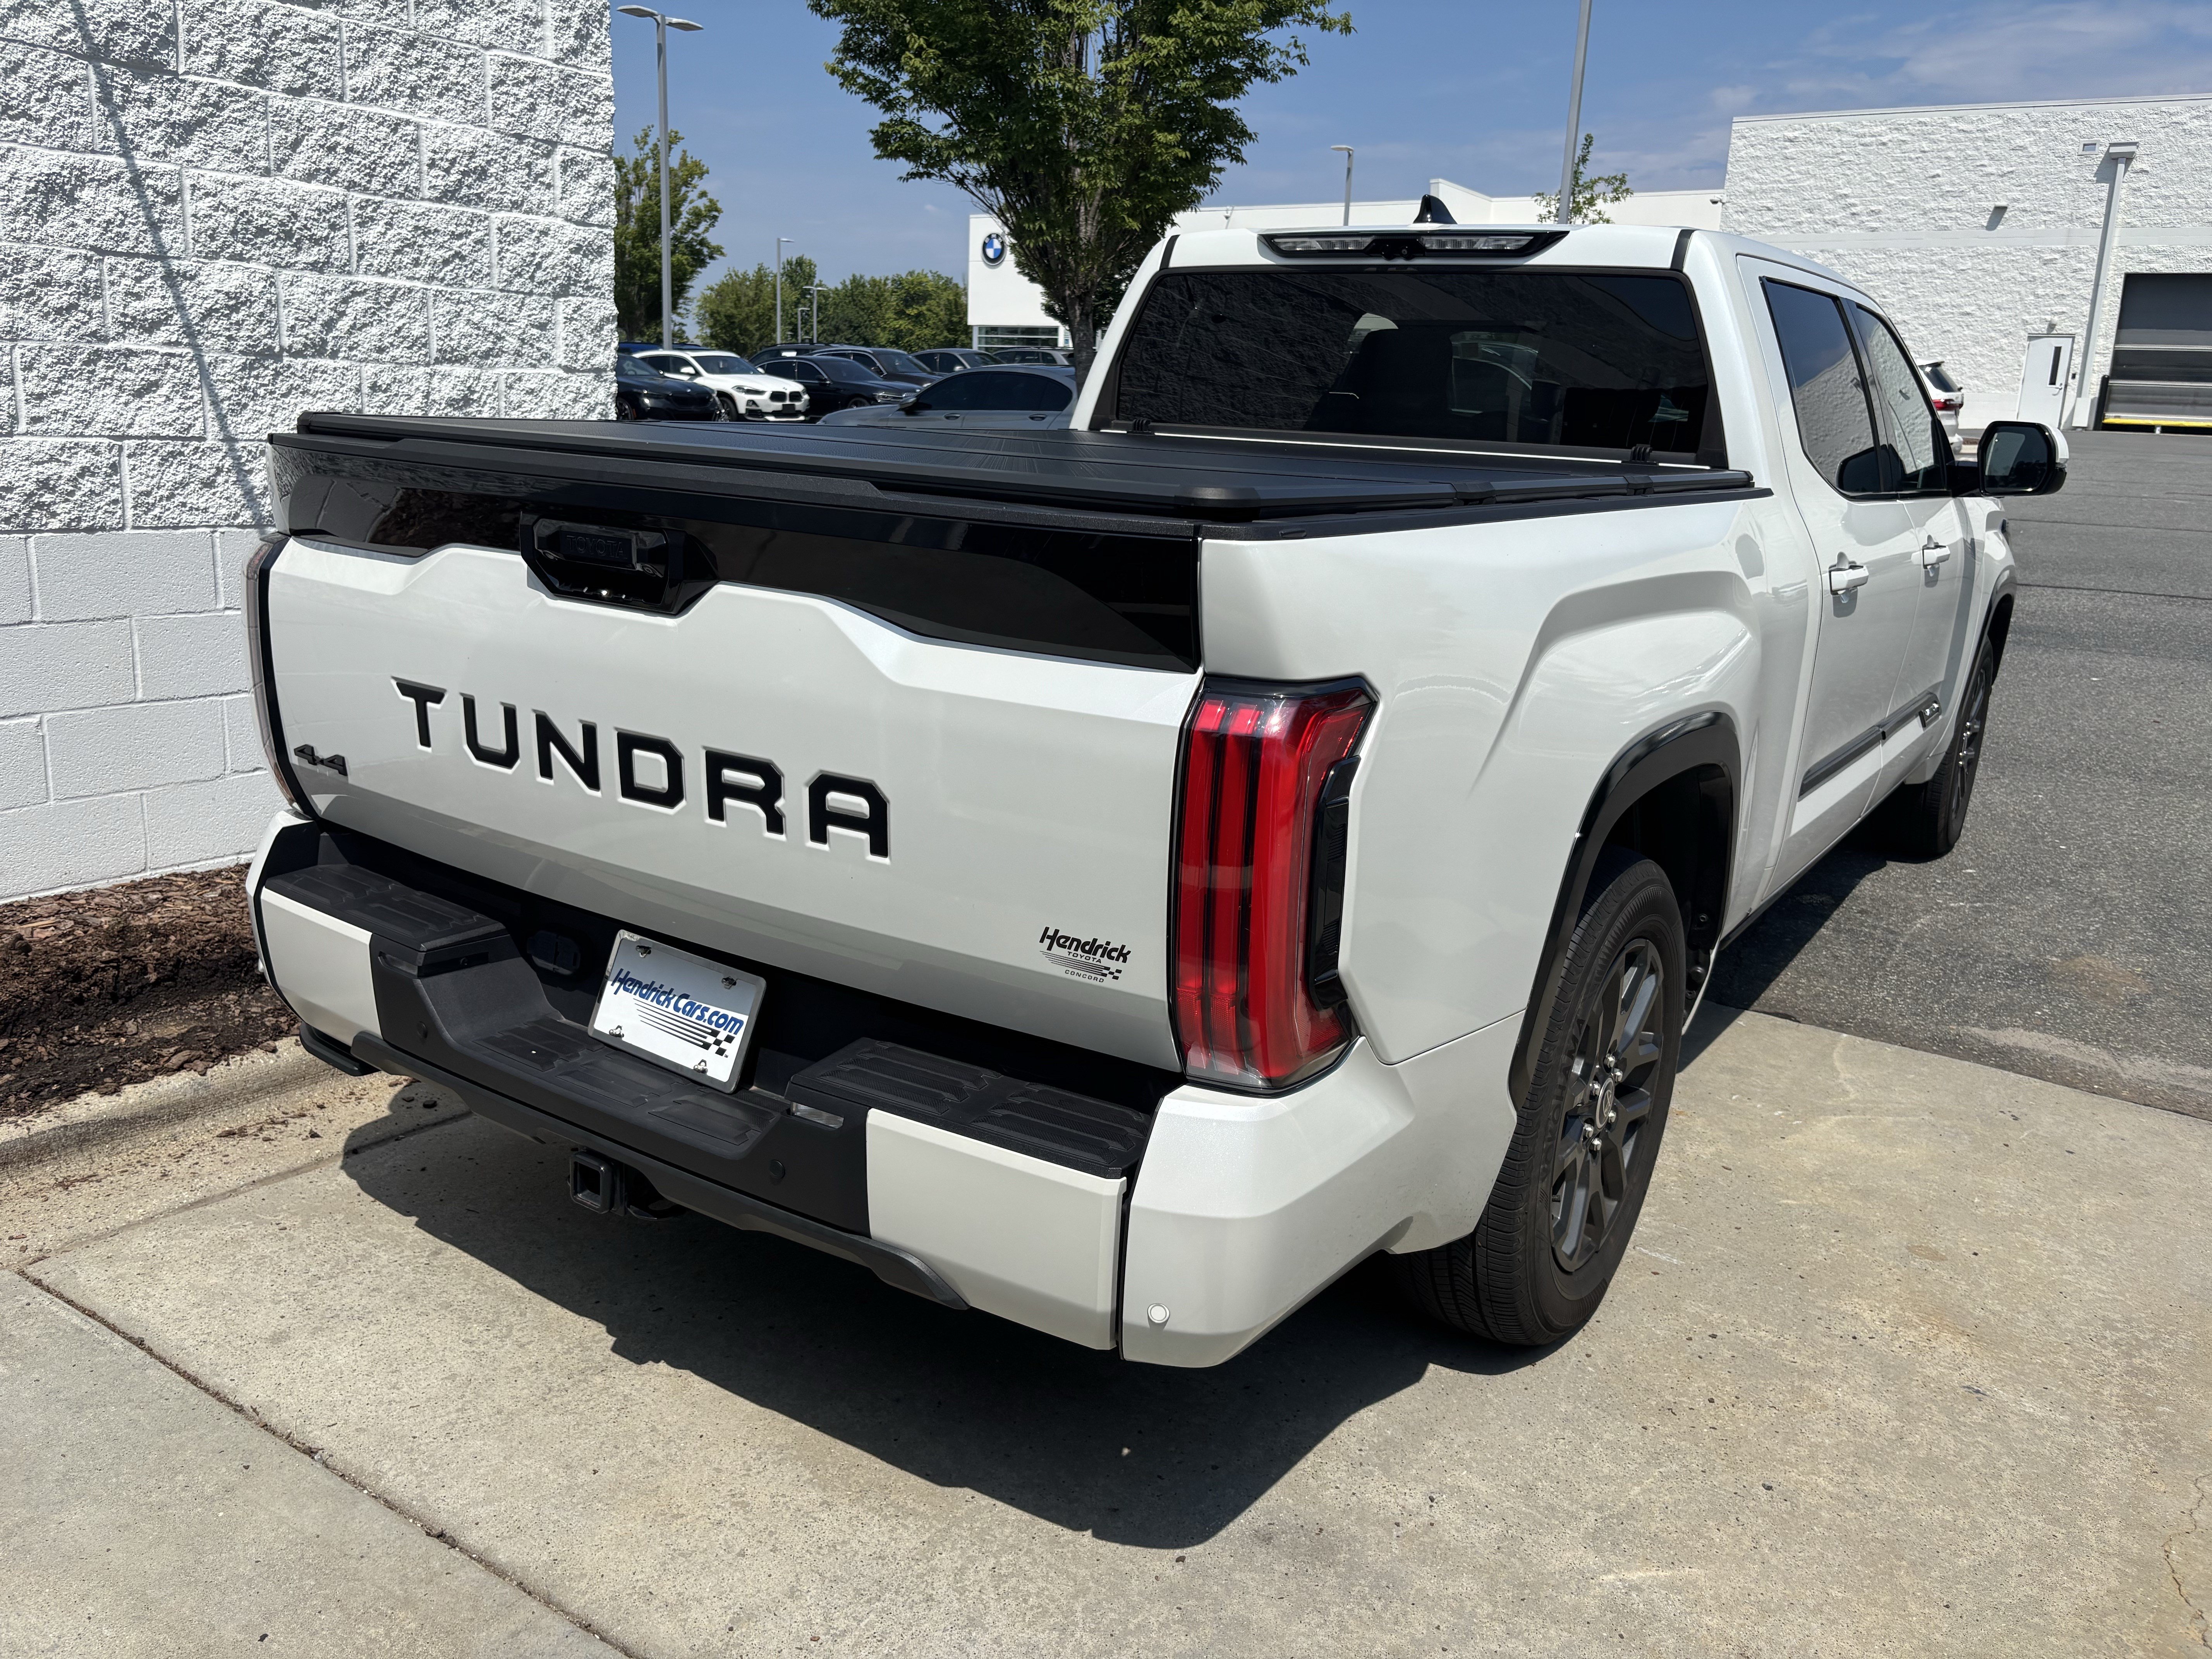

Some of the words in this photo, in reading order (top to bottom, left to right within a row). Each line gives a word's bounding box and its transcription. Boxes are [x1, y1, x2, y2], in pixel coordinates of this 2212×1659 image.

[567, 535, 628, 559] TOYOTA
[392, 678, 890, 862] TUNDRA
[1039, 926, 1131, 963] Hendrick
[1067, 951, 1101, 963] TOYOTA
[1065, 970, 1104, 982] CONCORD
